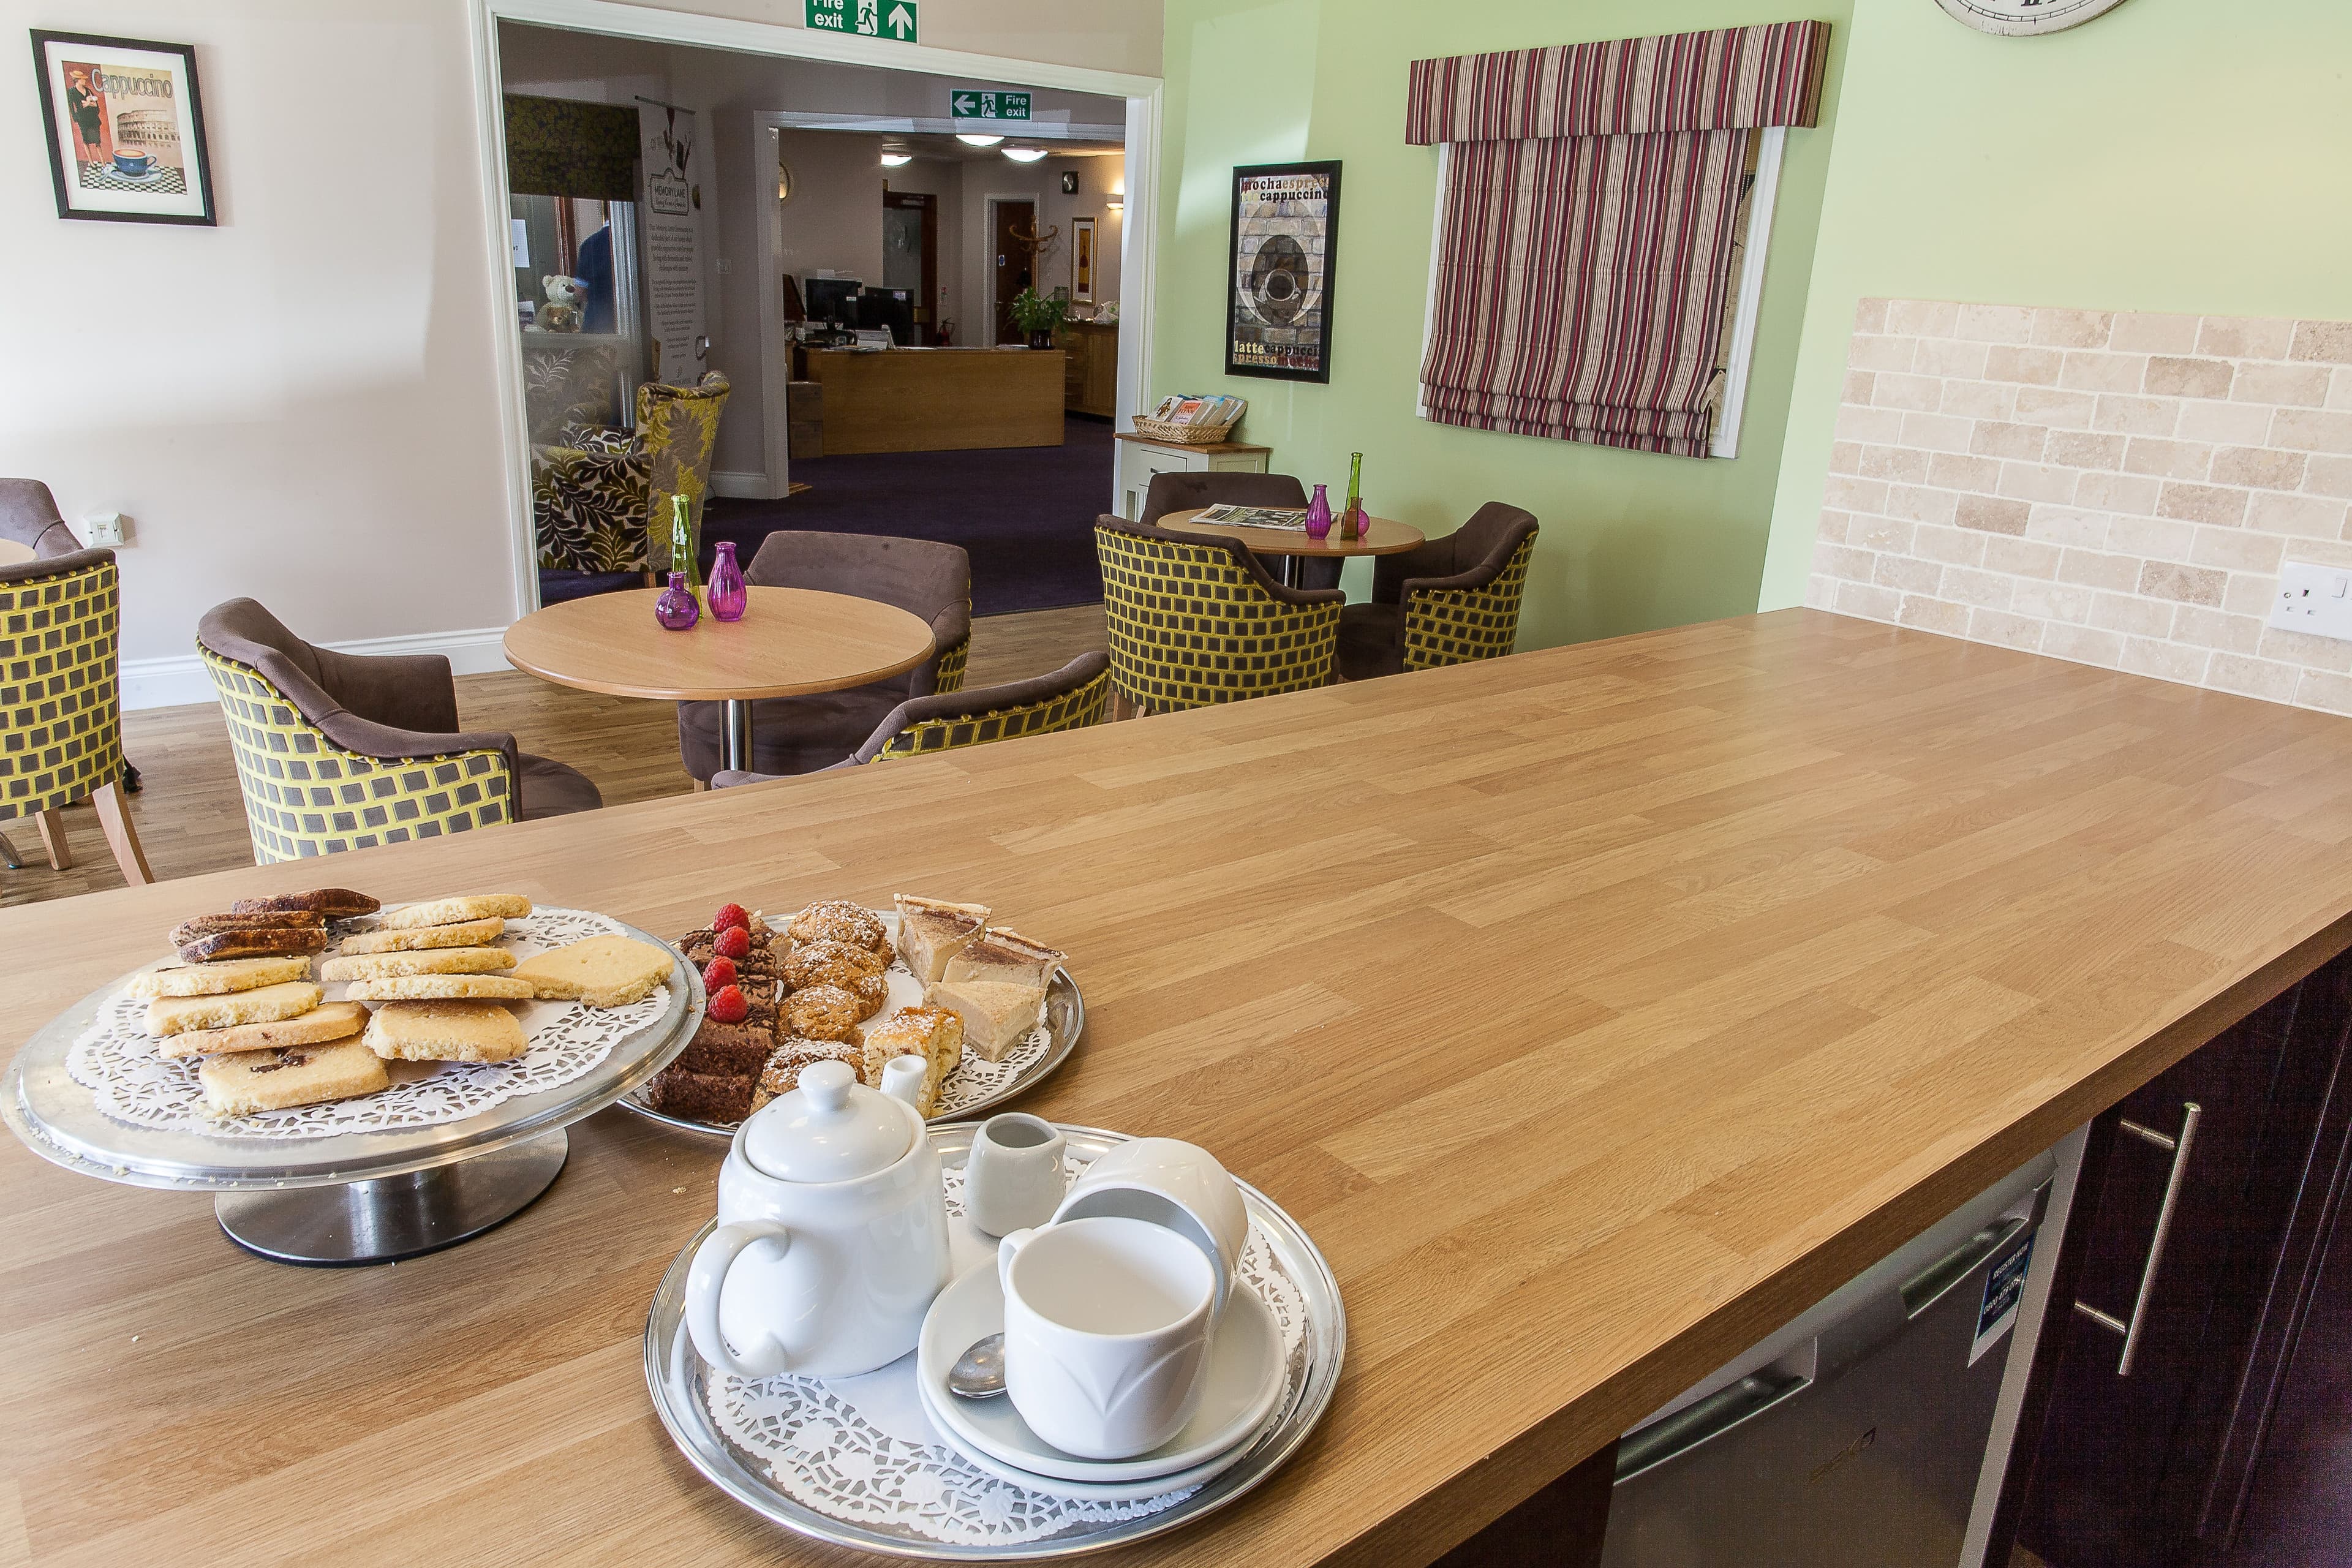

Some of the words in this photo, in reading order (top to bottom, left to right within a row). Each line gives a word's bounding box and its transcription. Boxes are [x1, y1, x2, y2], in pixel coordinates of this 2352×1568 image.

[815, 12, 843, 29] exit
[91, 68, 173, 100] Cappuccino
[1006, 95, 1027, 105] Fire
[1006, 107, 1026, 116] exit
[654, 186, 674, 196] MEMORY
[674, 187, 685, 198] LANE
[1234, 340, 1264, 355] latte
